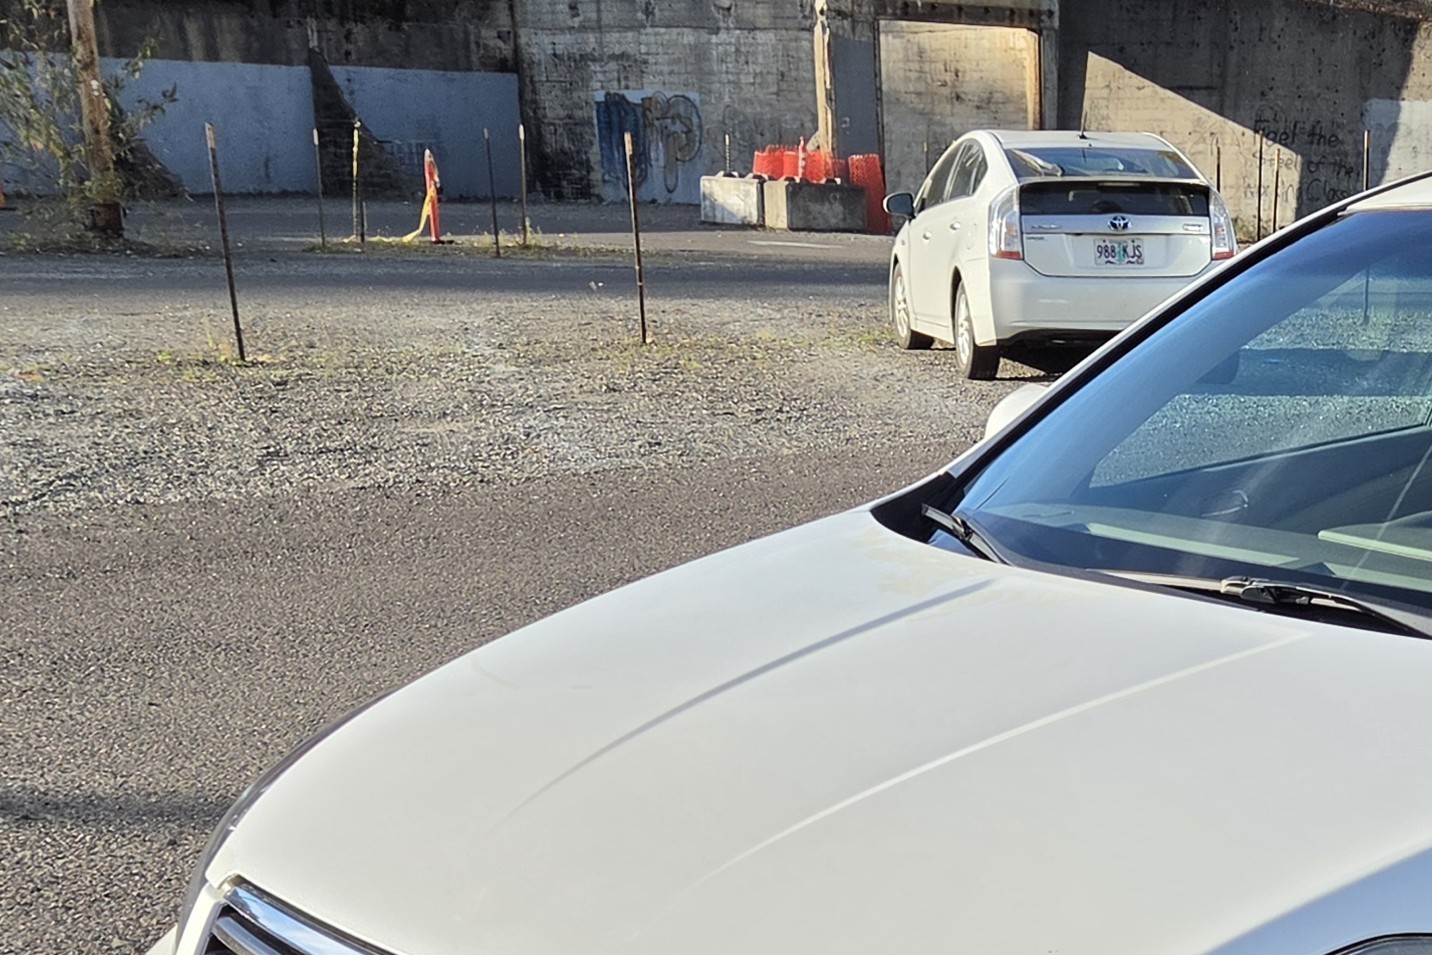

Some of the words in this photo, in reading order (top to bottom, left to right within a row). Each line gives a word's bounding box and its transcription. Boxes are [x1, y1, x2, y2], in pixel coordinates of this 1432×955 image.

[1306, 122, 1340, 148] the
[1307, 155, 1327, 174] of
[1097, 244, 1116, 259] 988
[1122, 244, 1143, 259] KJS
